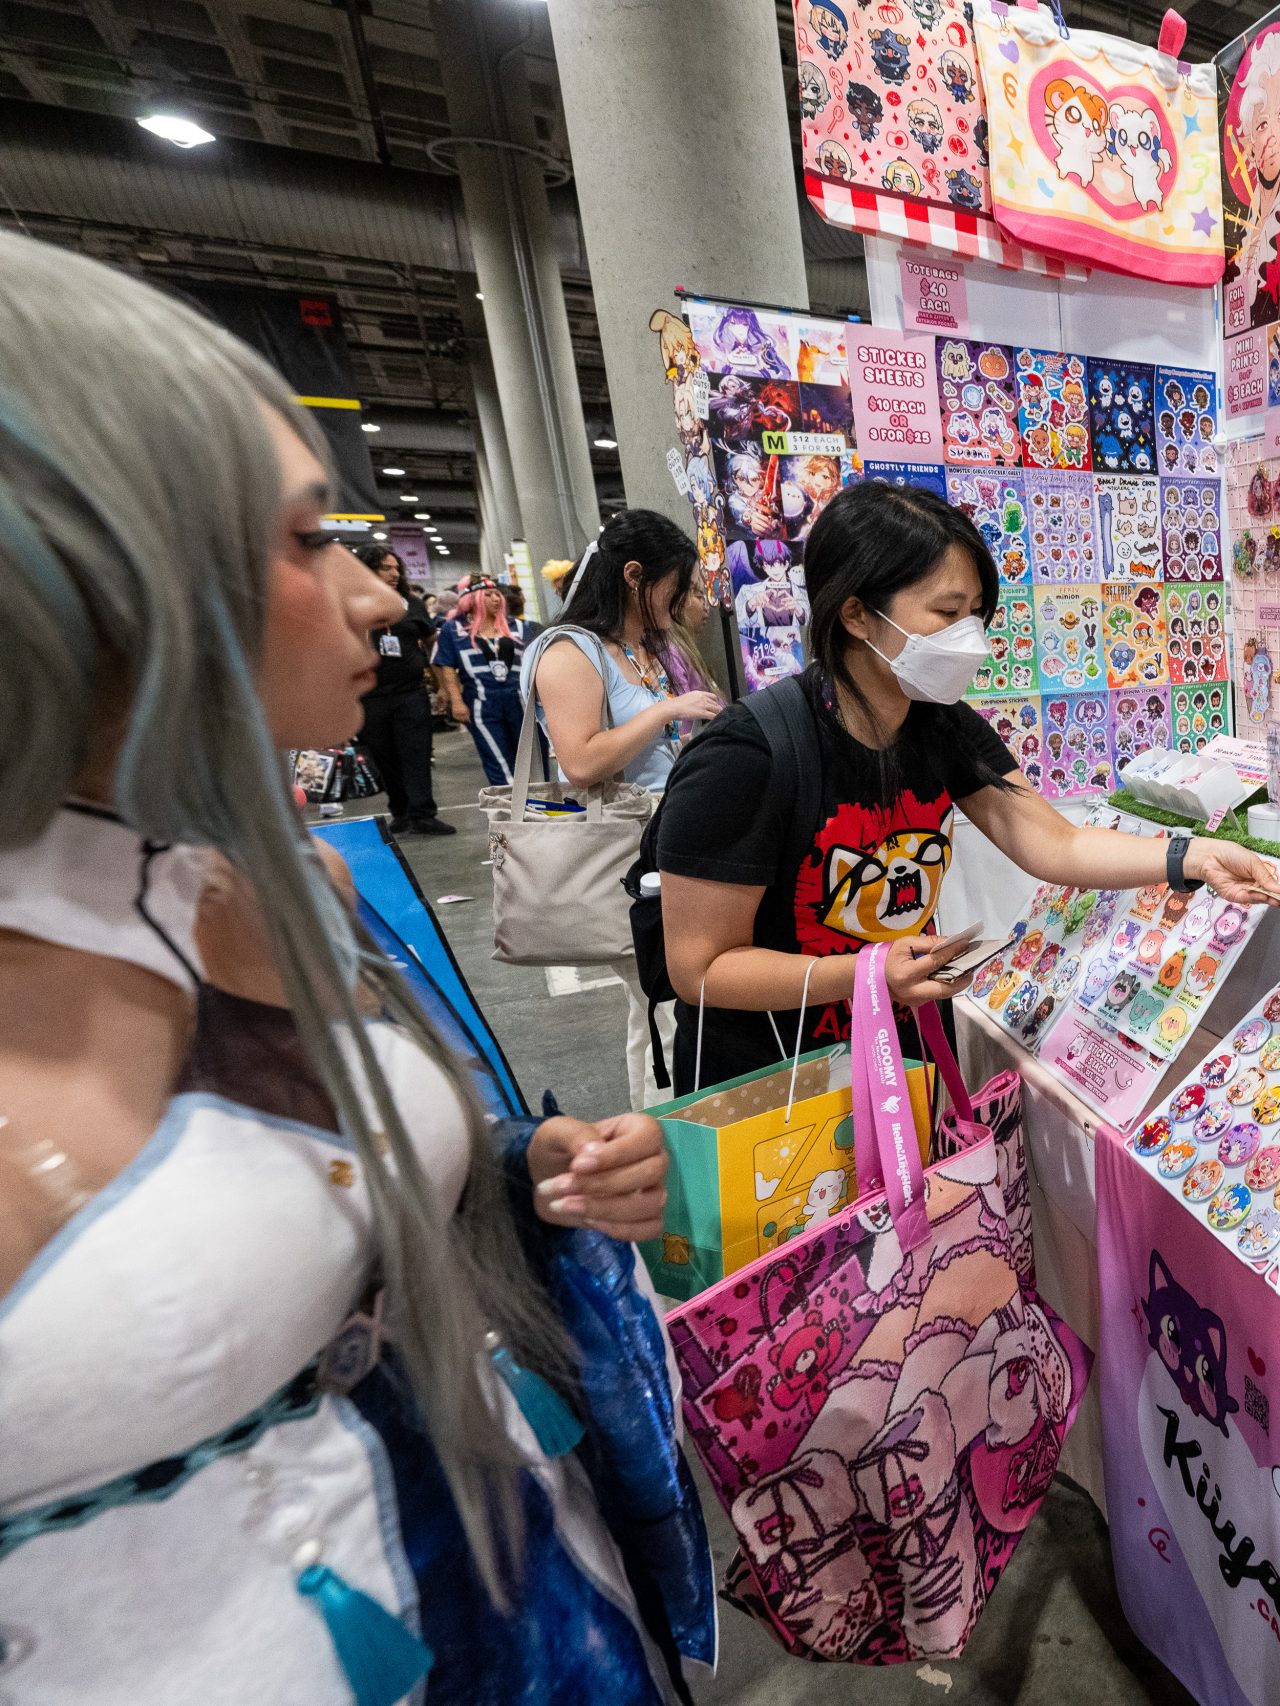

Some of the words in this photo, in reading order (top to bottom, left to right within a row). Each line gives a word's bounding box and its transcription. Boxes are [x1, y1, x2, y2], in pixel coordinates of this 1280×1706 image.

[906, 262, 932, 276] TOTE
[932, 267, 958, 281] BAGS
[920, 278, 947, 297] $40
[1228, 286, 1244, 302] FOIL
[920, 297, 950, 313] EACH
[1228, 309, 1245, 328] $25
[1235, 336, 1253, 356] MINI
[858, 346, 927, 369] STICKER
[1230, 351, 1260, 372] PRINTS
[863, 366, 925, 388] SHEETS
[1239, 380, 1264, 400] EACH
[868, 396, 891, 412] $10
[891, 398, 926, 414] EACH
[890, 414, 909, 428] OR
[767, 435, 785, 450] M
[869, 427, 880, 441] 3
[880, 429, 905, 443] FOR
[905, 430, 932, 445] $25
[869, 463, 905, 473] GHOSTLY
[907, 465, 939, 473] FRIENDS
[878, 1028, 897, 1087] GLOOMY
[1087, 1042, 1118, 1068] STICKERS
